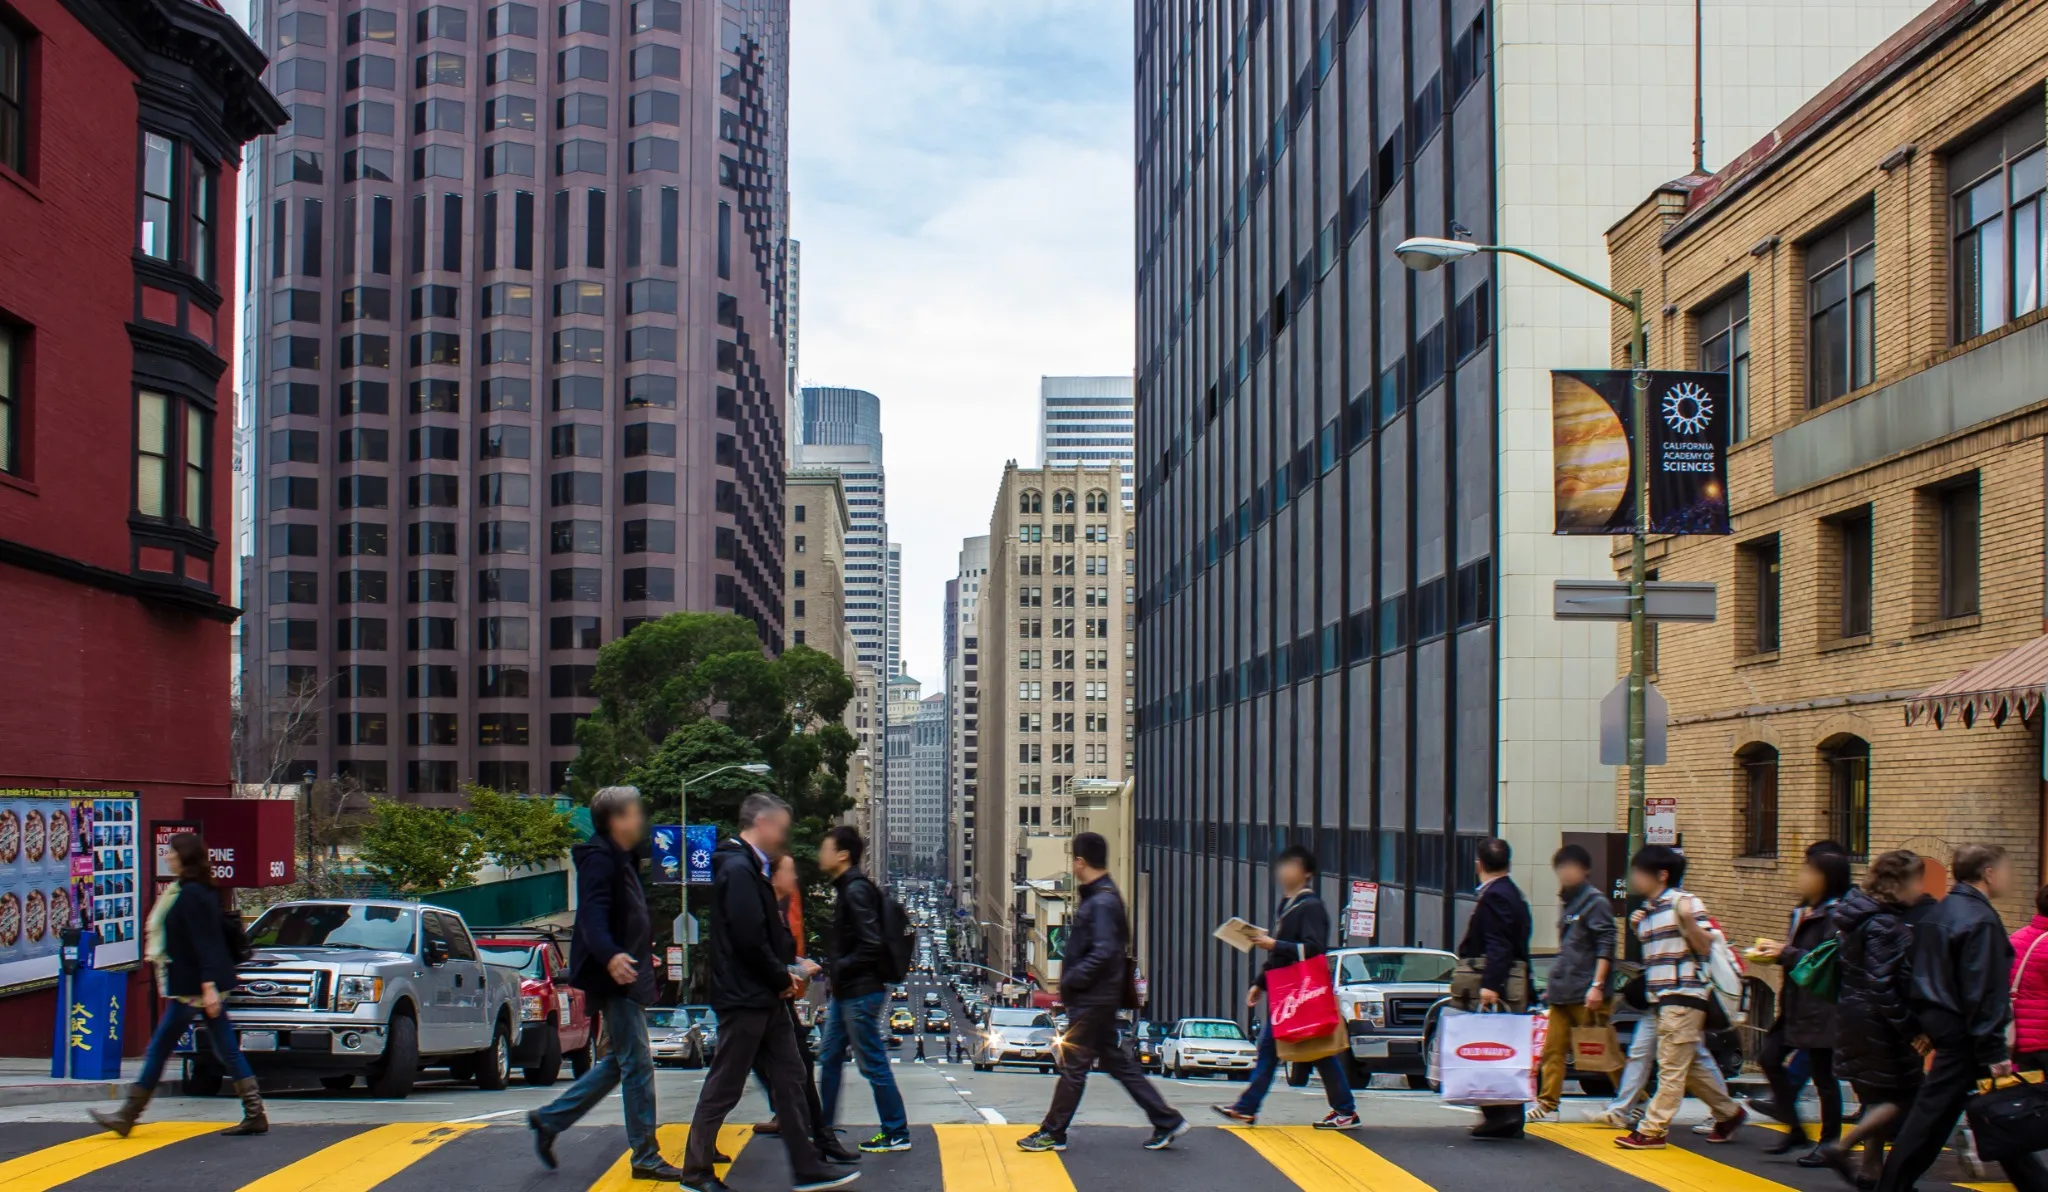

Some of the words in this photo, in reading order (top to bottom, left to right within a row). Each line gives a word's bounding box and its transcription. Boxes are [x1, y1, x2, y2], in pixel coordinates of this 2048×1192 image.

[1663, 441, 1714, 450] CALIFORNIA
[1663, 452, 1702, 460] ACADEMY
[1703, 452, 1715, 460] OF
[1663, 461, 1716, 472] SCIENCES
[208, 848, 235, 862] PINE
[269, 861, 285, 878] 560
